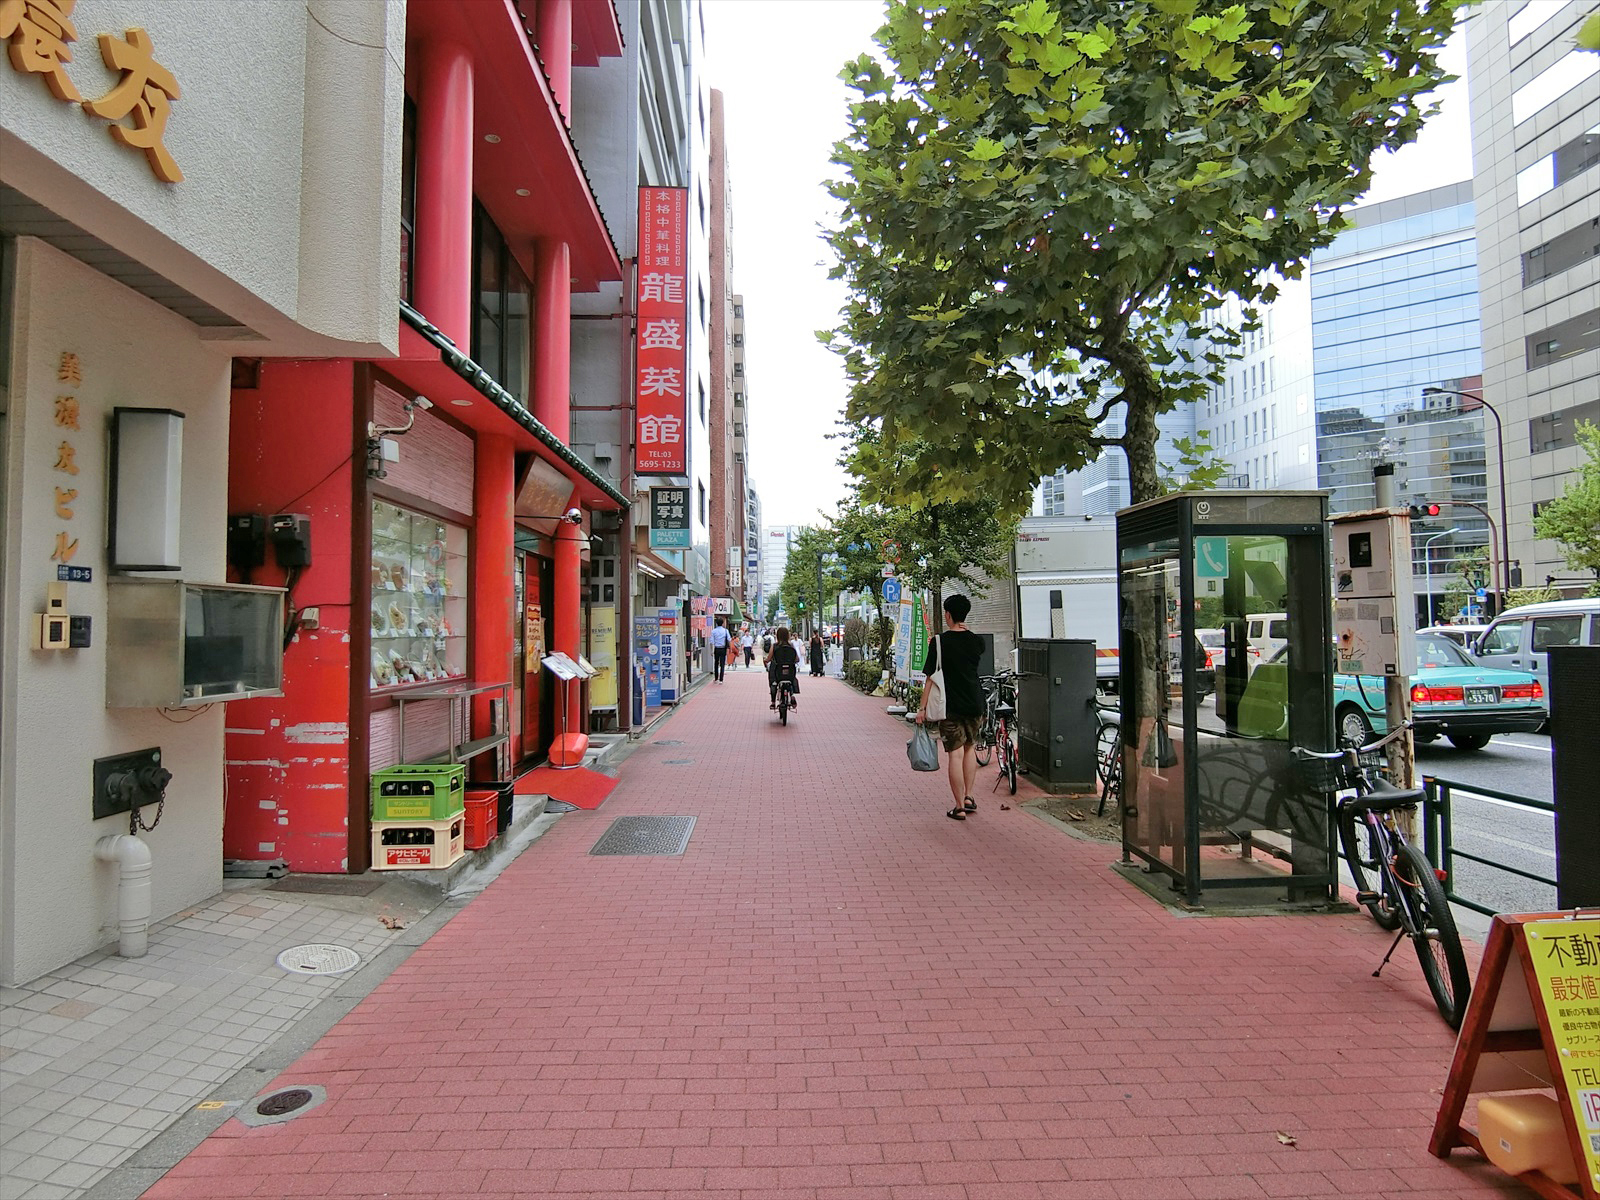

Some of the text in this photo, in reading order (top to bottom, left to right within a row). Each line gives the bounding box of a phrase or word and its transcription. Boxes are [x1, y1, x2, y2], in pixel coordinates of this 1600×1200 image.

[656, 191, 670, 266] 本格中華料理
[639, 273, 683, 445] 龍盛菜館
[649, 451, 672, 459] TEL:03
[639, 460, 681, 469] 5695-1233
[657, 491, 684, 504] 証明
[657, 505, 684, 518] 写真
[886, 584, 895, 600] P
[636, 630, 659, 638] ダビング
[661, 634, 672, 680] 証明写真
[387, 849, 430, 858] アサヒビール
[1543, 933, 1600, 968] 不動
[1562, 1021, 1600, 1031] 優良中古物
